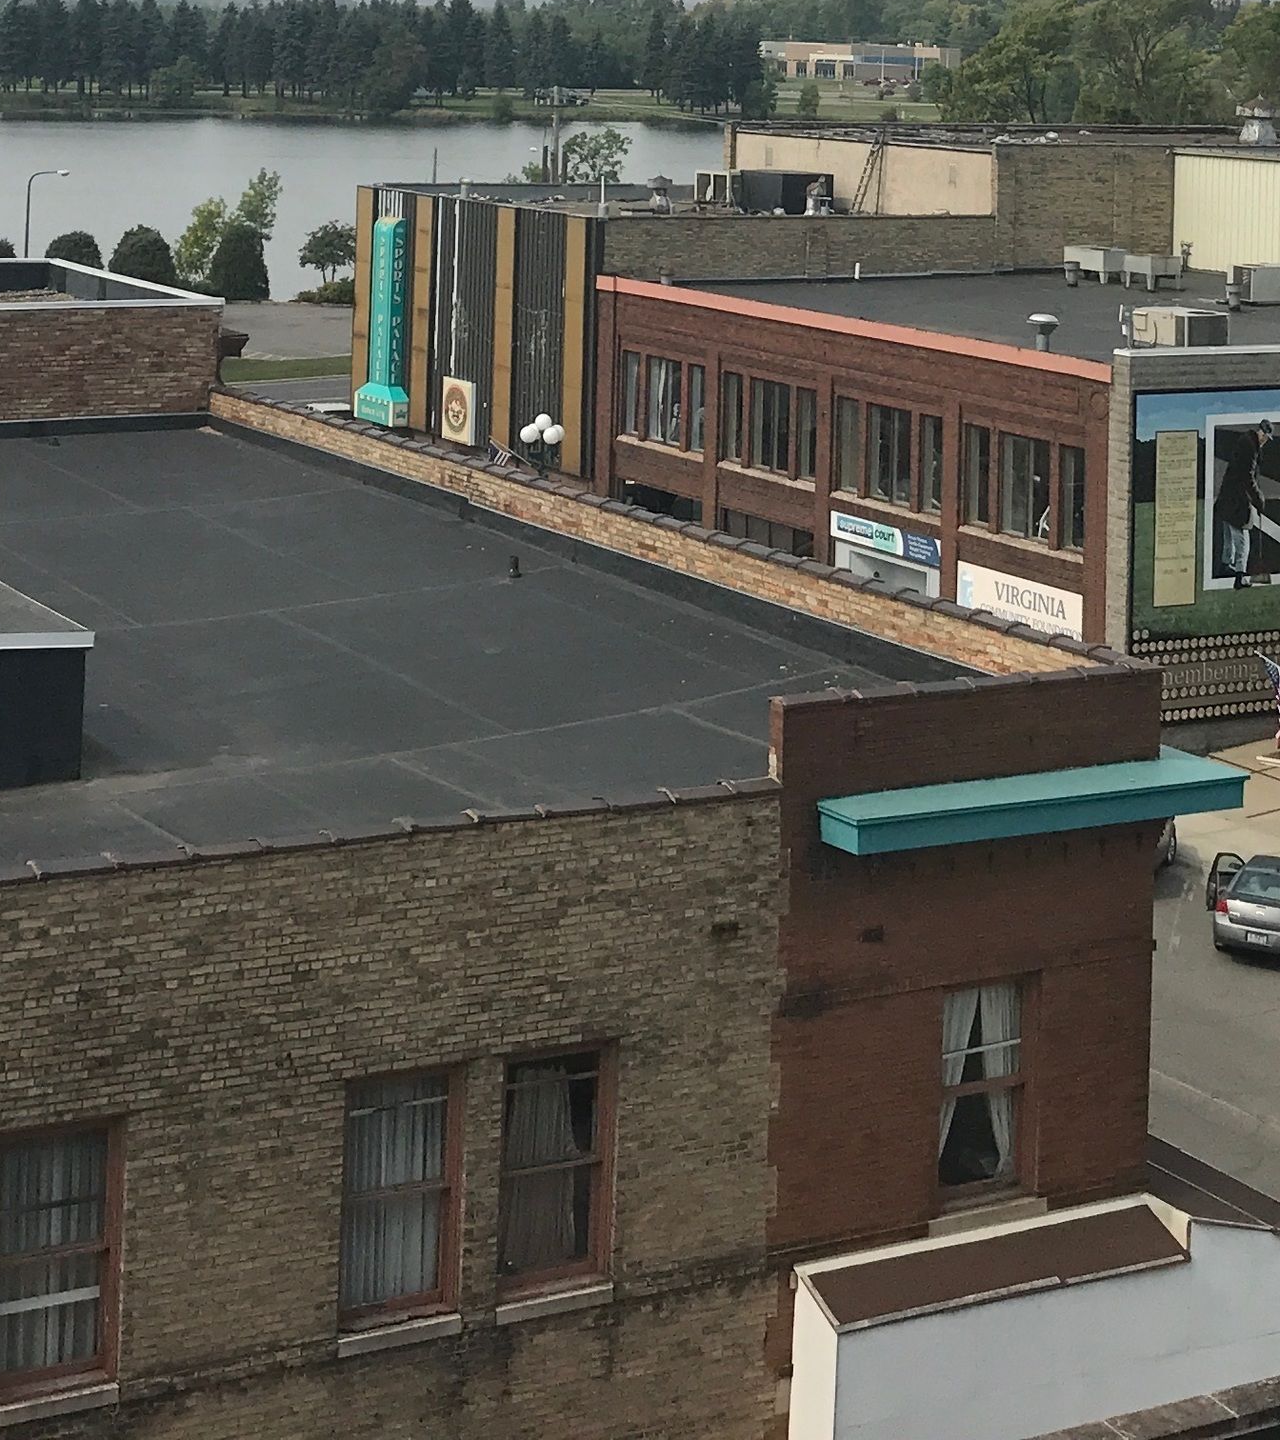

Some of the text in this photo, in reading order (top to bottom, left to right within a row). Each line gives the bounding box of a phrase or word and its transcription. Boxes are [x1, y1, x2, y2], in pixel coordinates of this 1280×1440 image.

[393, 237, 404, 304] SPORTS
[391, 316, 401, 384] PALACE
[839, 519, 872, 537] supreme
[874, 528, 895, 543] court
[994, 581, 1067, 620] VIRGINIA
